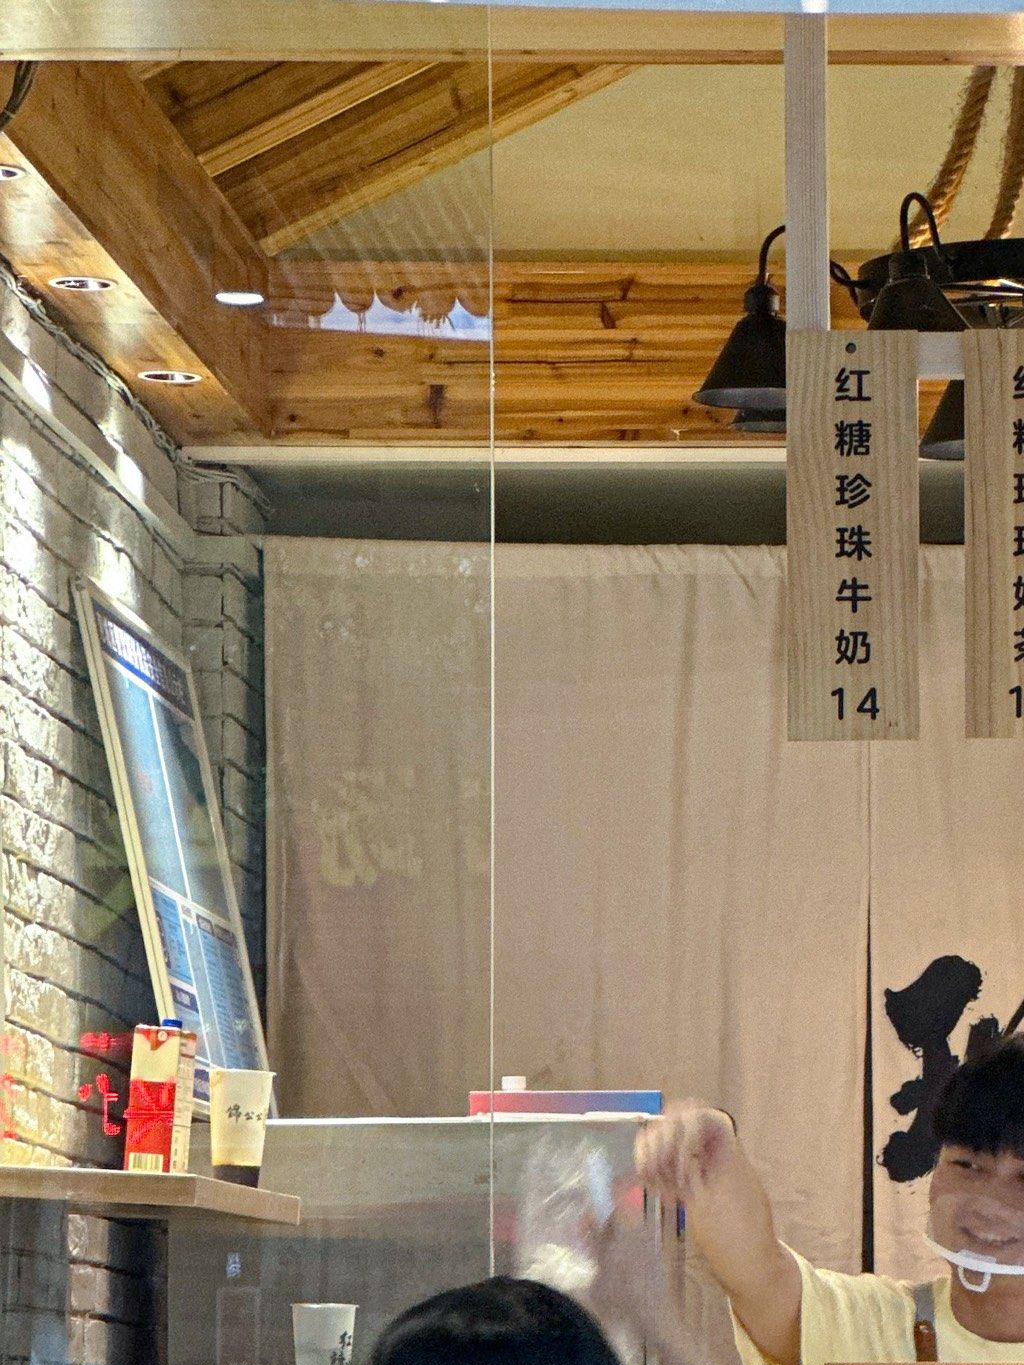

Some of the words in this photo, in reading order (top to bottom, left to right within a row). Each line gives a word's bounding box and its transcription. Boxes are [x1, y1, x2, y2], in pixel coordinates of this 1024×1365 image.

[834, 366, 873, 665] 红糖珍珠牛奶
[830, 687, 880, 721] 14
